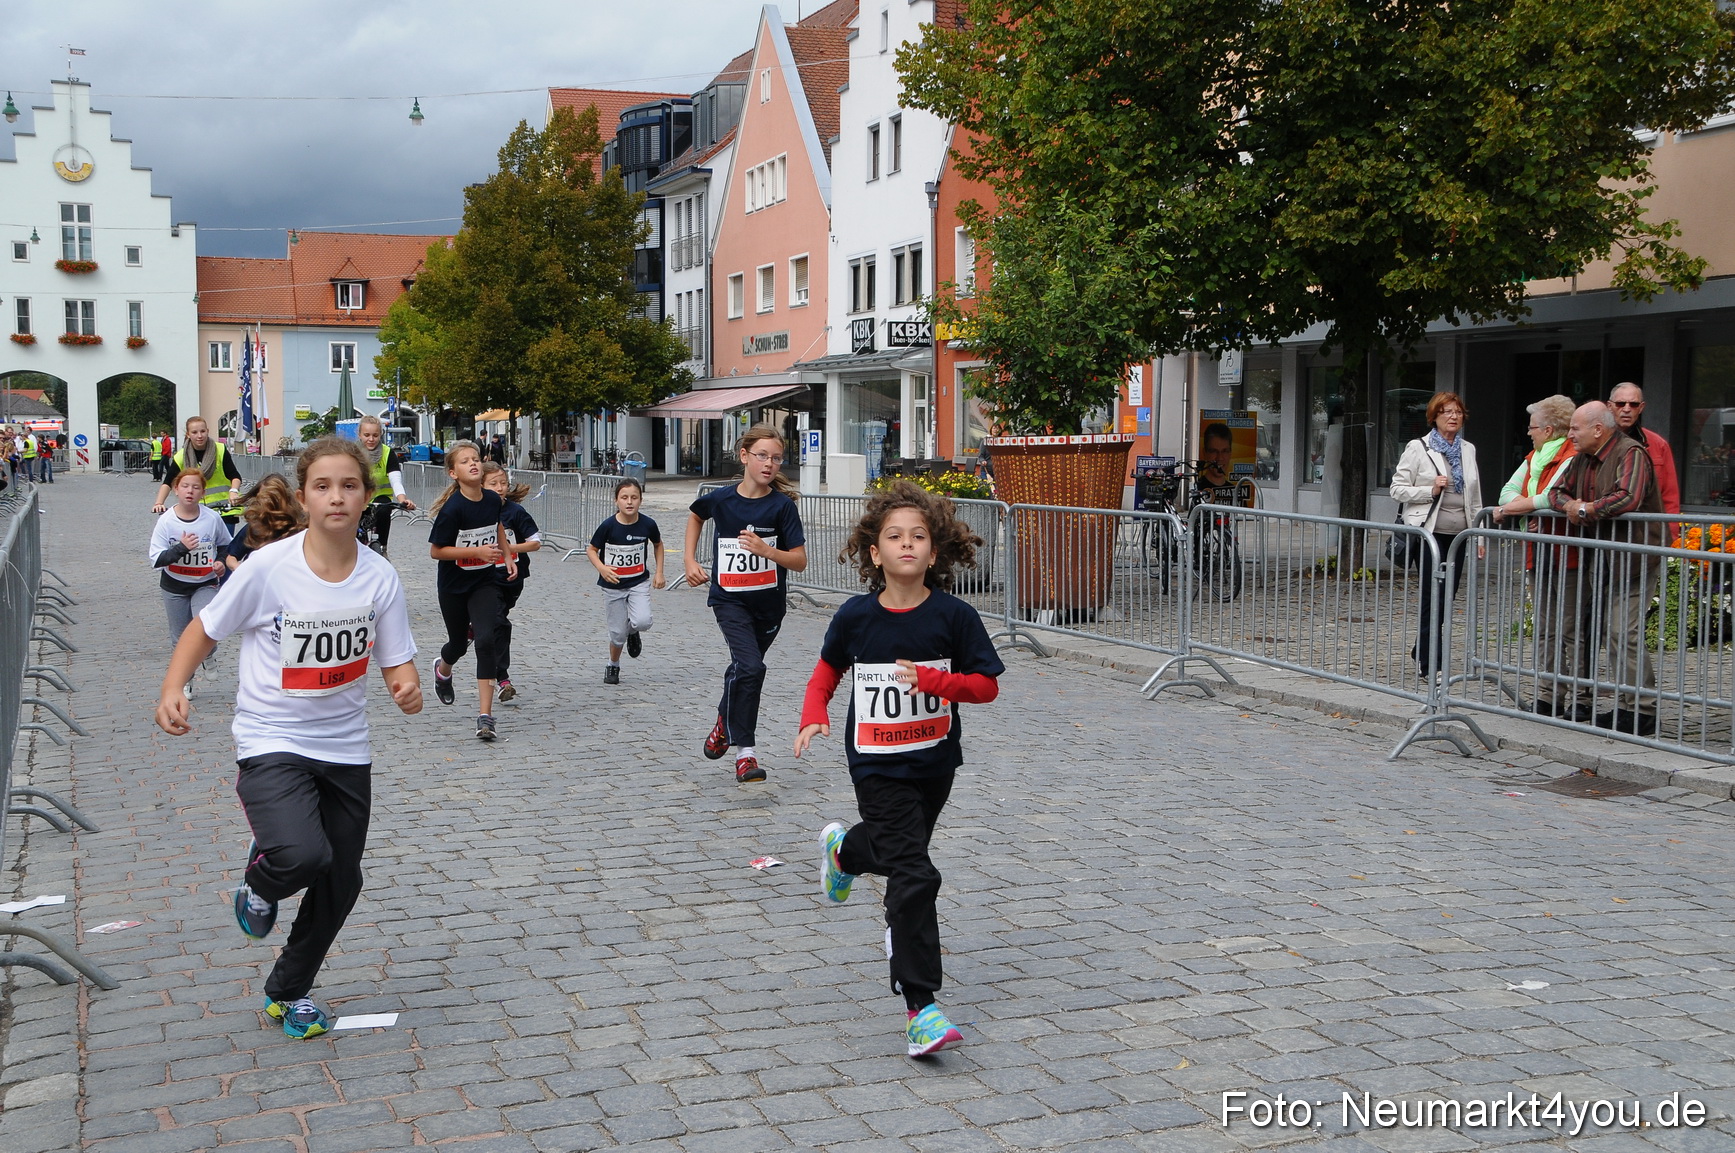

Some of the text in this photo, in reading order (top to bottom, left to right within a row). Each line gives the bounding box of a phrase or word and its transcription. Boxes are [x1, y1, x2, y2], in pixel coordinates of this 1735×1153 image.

[853, 320, 871, 339] KBK
[891, 323, 932, 337] KBK
[389, 398, 394, 410] P
[811, 434, 818, 445] P
[177, 551, 209, 566] 015
[609, 552, 641, 567] 7336
[725, 553, 769, 573] 7301
[284, 615, 366, 630] PARTL Neumarkt
[293, 627, 369, 664] 7003
[319, 672, 345, 686] Lisa
[857, 672, 886, 682] PARTL
[873, 725, 936, 742] Franziska
